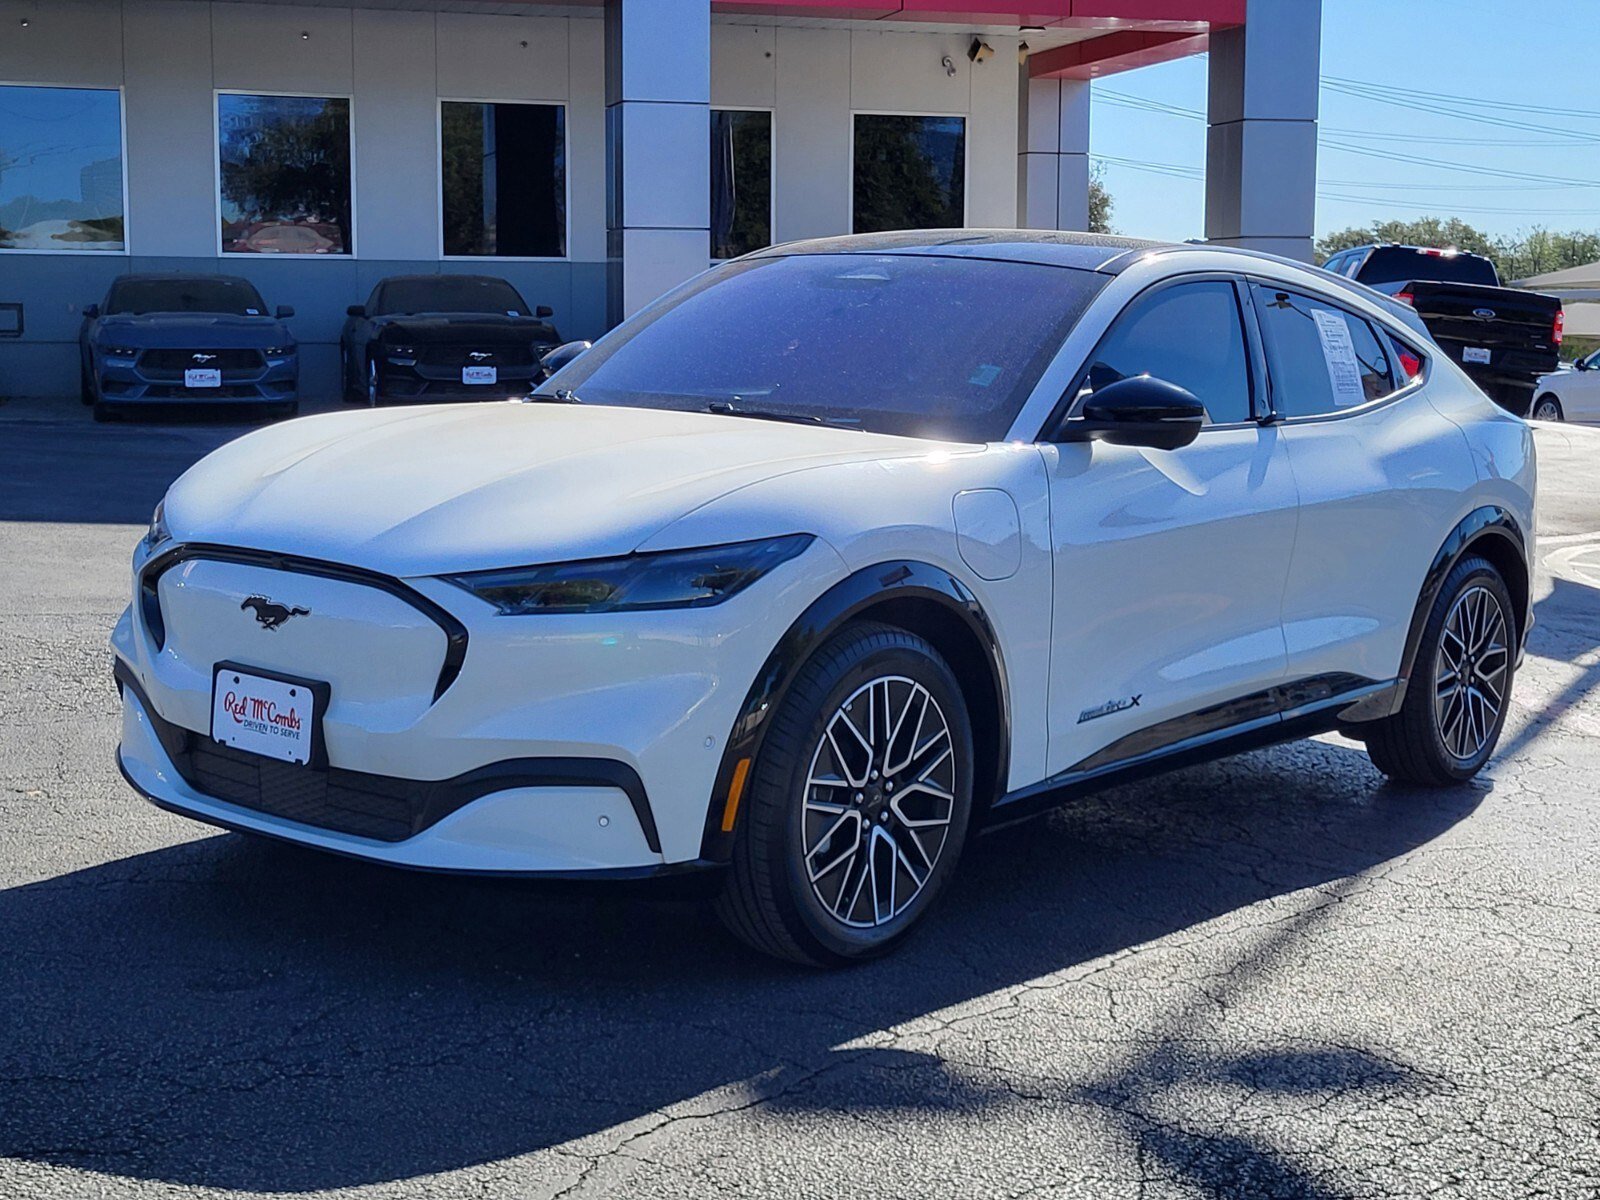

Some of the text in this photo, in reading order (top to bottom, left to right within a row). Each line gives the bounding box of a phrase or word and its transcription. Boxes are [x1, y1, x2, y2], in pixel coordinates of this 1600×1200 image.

[224, 691, 301, 730] Red McCombs
[243, 719, 300, 740] DRIVEN TO SERVE
